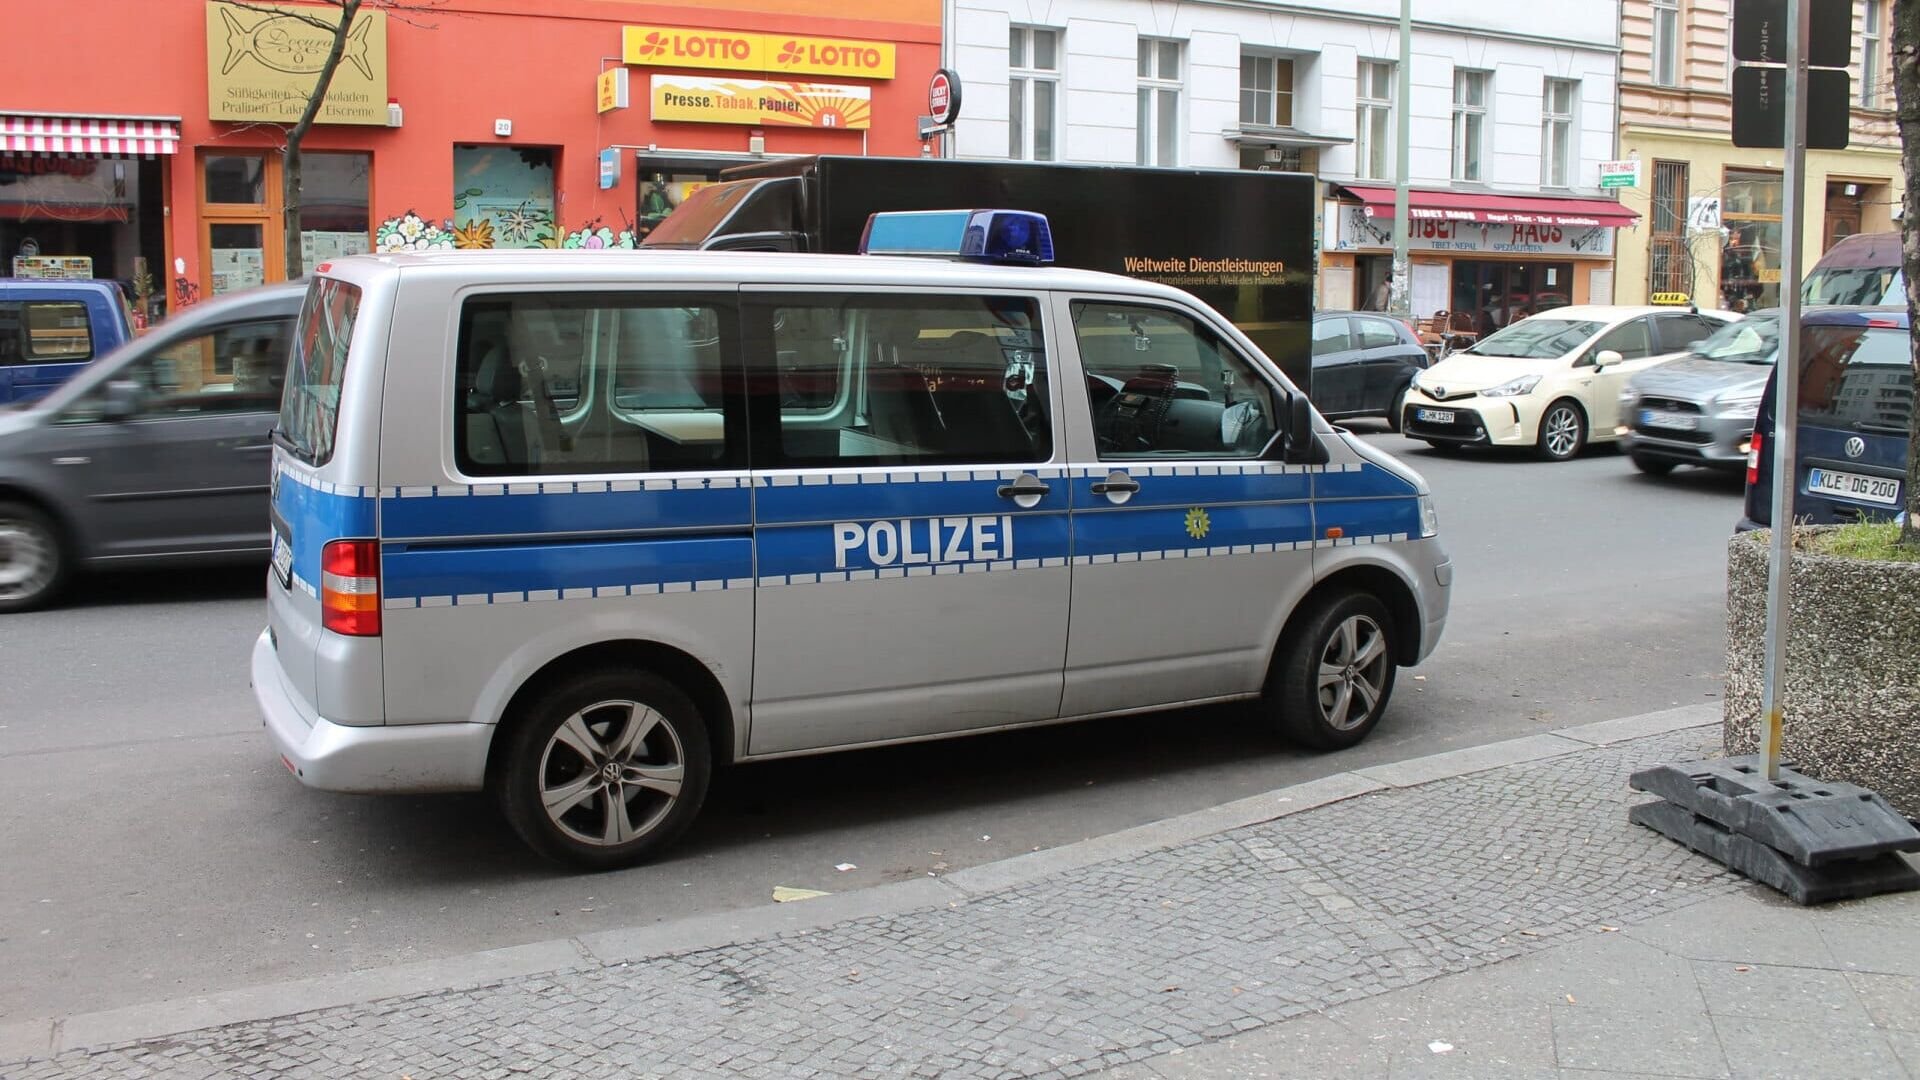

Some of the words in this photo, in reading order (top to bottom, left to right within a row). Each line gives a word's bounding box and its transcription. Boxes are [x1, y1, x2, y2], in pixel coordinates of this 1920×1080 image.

[674, 36, 750, 60] LOTTO
[809, 44, 881, 68] LOTTO
[1759, 20, 1769, 112] haltevbot123
[227, 87, 291, 102] Süßigkeiten
[301, 89, 369, 103] Skoladen
[664, 92, 714, 108] Presse.
[716, 95, 757, 110] Tabak.
[758, 97, 803, 114] Papier.
[222, 102, 269, 114] Pralinen
[326, 105, 374, 118] Eiscreme
[822, 113, 836, 127] 61
[498, 123, 509, 131] 20
[1410, 208, 1442, 218] TIBET
[1445, 210, 1476, 220] HAUS
[1511, 224, 1562, 246] HAUS
[1124, 257, 1186, 273] Weltweite
[1189, 257, 1283, 276] Dienstleistungen
[1819, 472, 1843, 489] KLE
[1851, 477, 1869, 493] DG
[1870, 481, 1896, 498] 200
[834, 515, 1013, 569] POLIZEI
